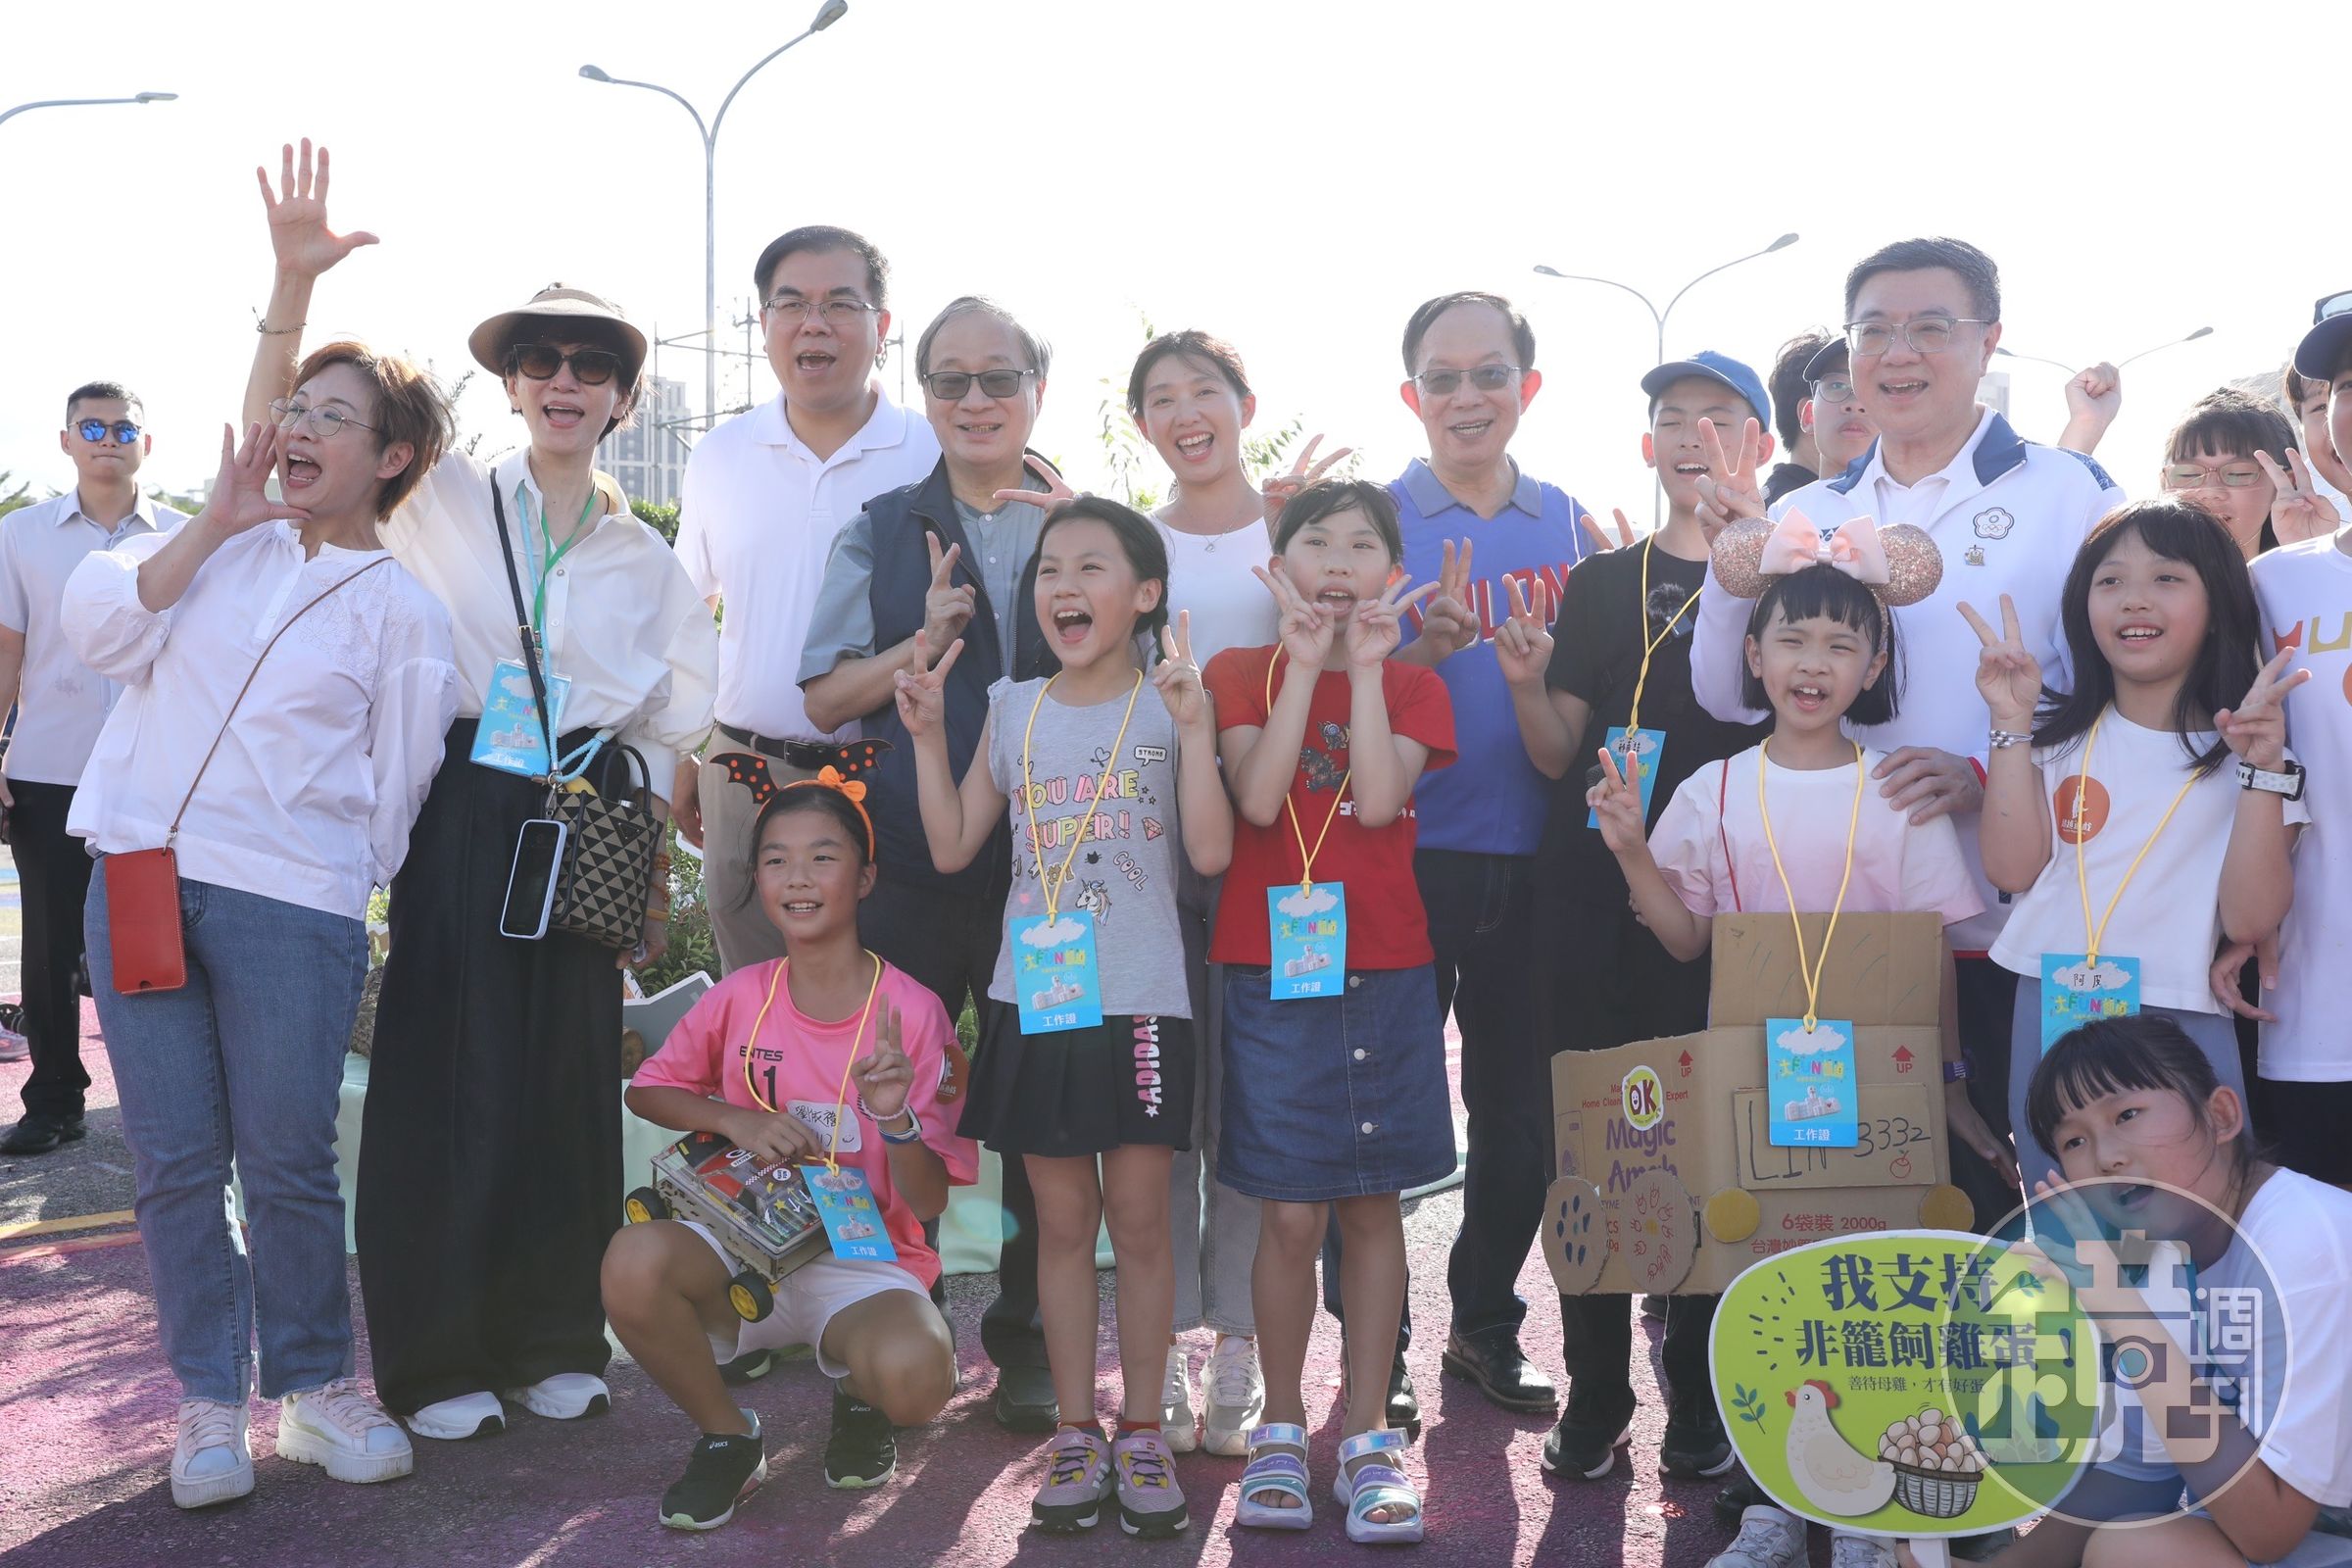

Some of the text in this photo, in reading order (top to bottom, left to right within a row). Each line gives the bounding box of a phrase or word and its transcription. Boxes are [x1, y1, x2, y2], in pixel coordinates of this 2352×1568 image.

[1012, 769, 1139, 815] YOU ARE
[1113, 851, 1150, 892] COOL
[1043, 1012, 1076, 1027] 工作證
[1681, 1067, 1692, 1078] UP
[1896, 1062, 1913, 1074] UP
[1582, 1099, 1600, 1108] Home
[1666, 1090, 1689, 1102] Expert
[1629, 1079, 1657, 1115] OK
[1606, 1118, 1677, 1156] Magic
[1794, 1129, 1831, 1142] 工作證
[1782, 1213, 1887, 1232] 6袋裝 2000g
[1820, 1252, 1997, 1313] 我支持
